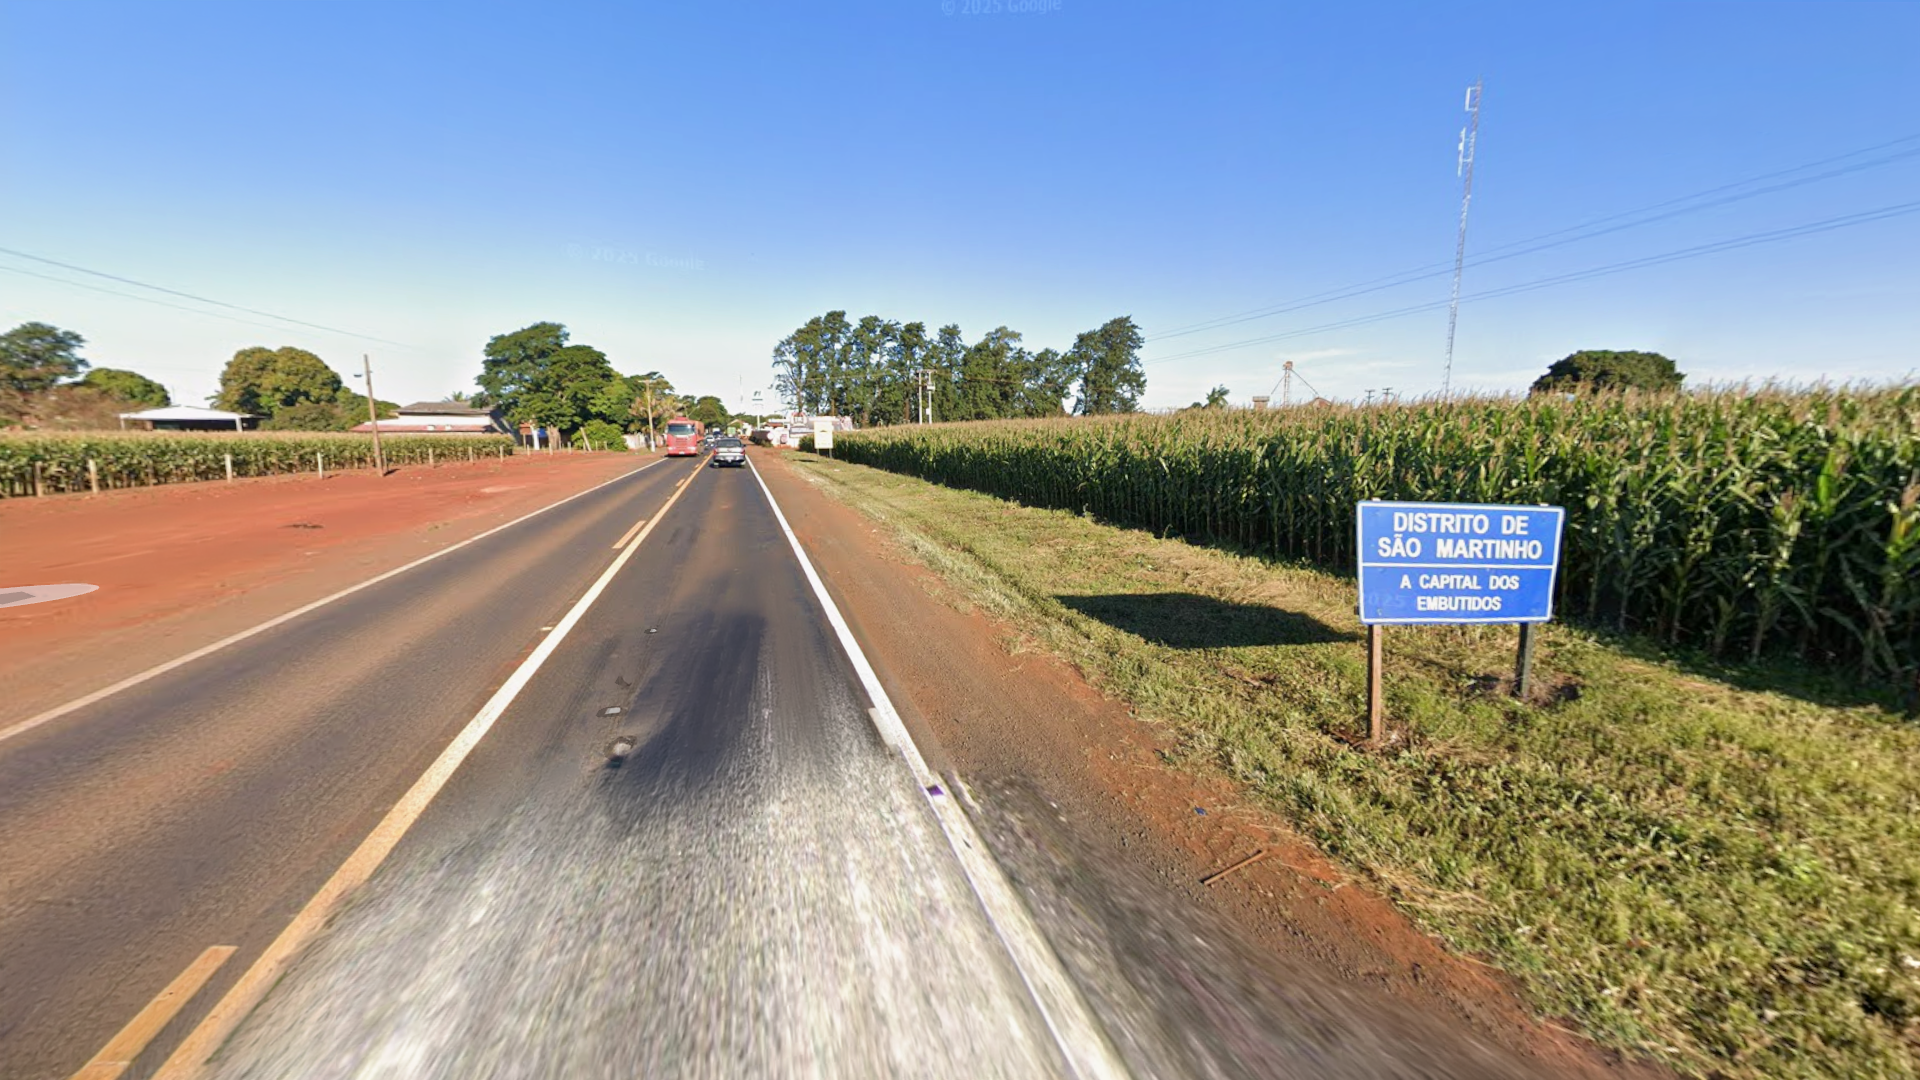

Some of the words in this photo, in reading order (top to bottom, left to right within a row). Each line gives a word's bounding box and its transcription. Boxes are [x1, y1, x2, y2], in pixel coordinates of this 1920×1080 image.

[1393, 512, 1490, 533] DISTRITO
[1501, 515, 1529, 535] DE
[1377, 533, 1422, 558] SÃO
[1436, 538, 1543, 560] MARTINHO
[1400, 574, 1412, 589] A
[1419, 574, 1482, 590] CAPITAL
[1489, 575, 1520, 590] DOS
[1417, 595, 1502, 611] EMBUTIDOS
